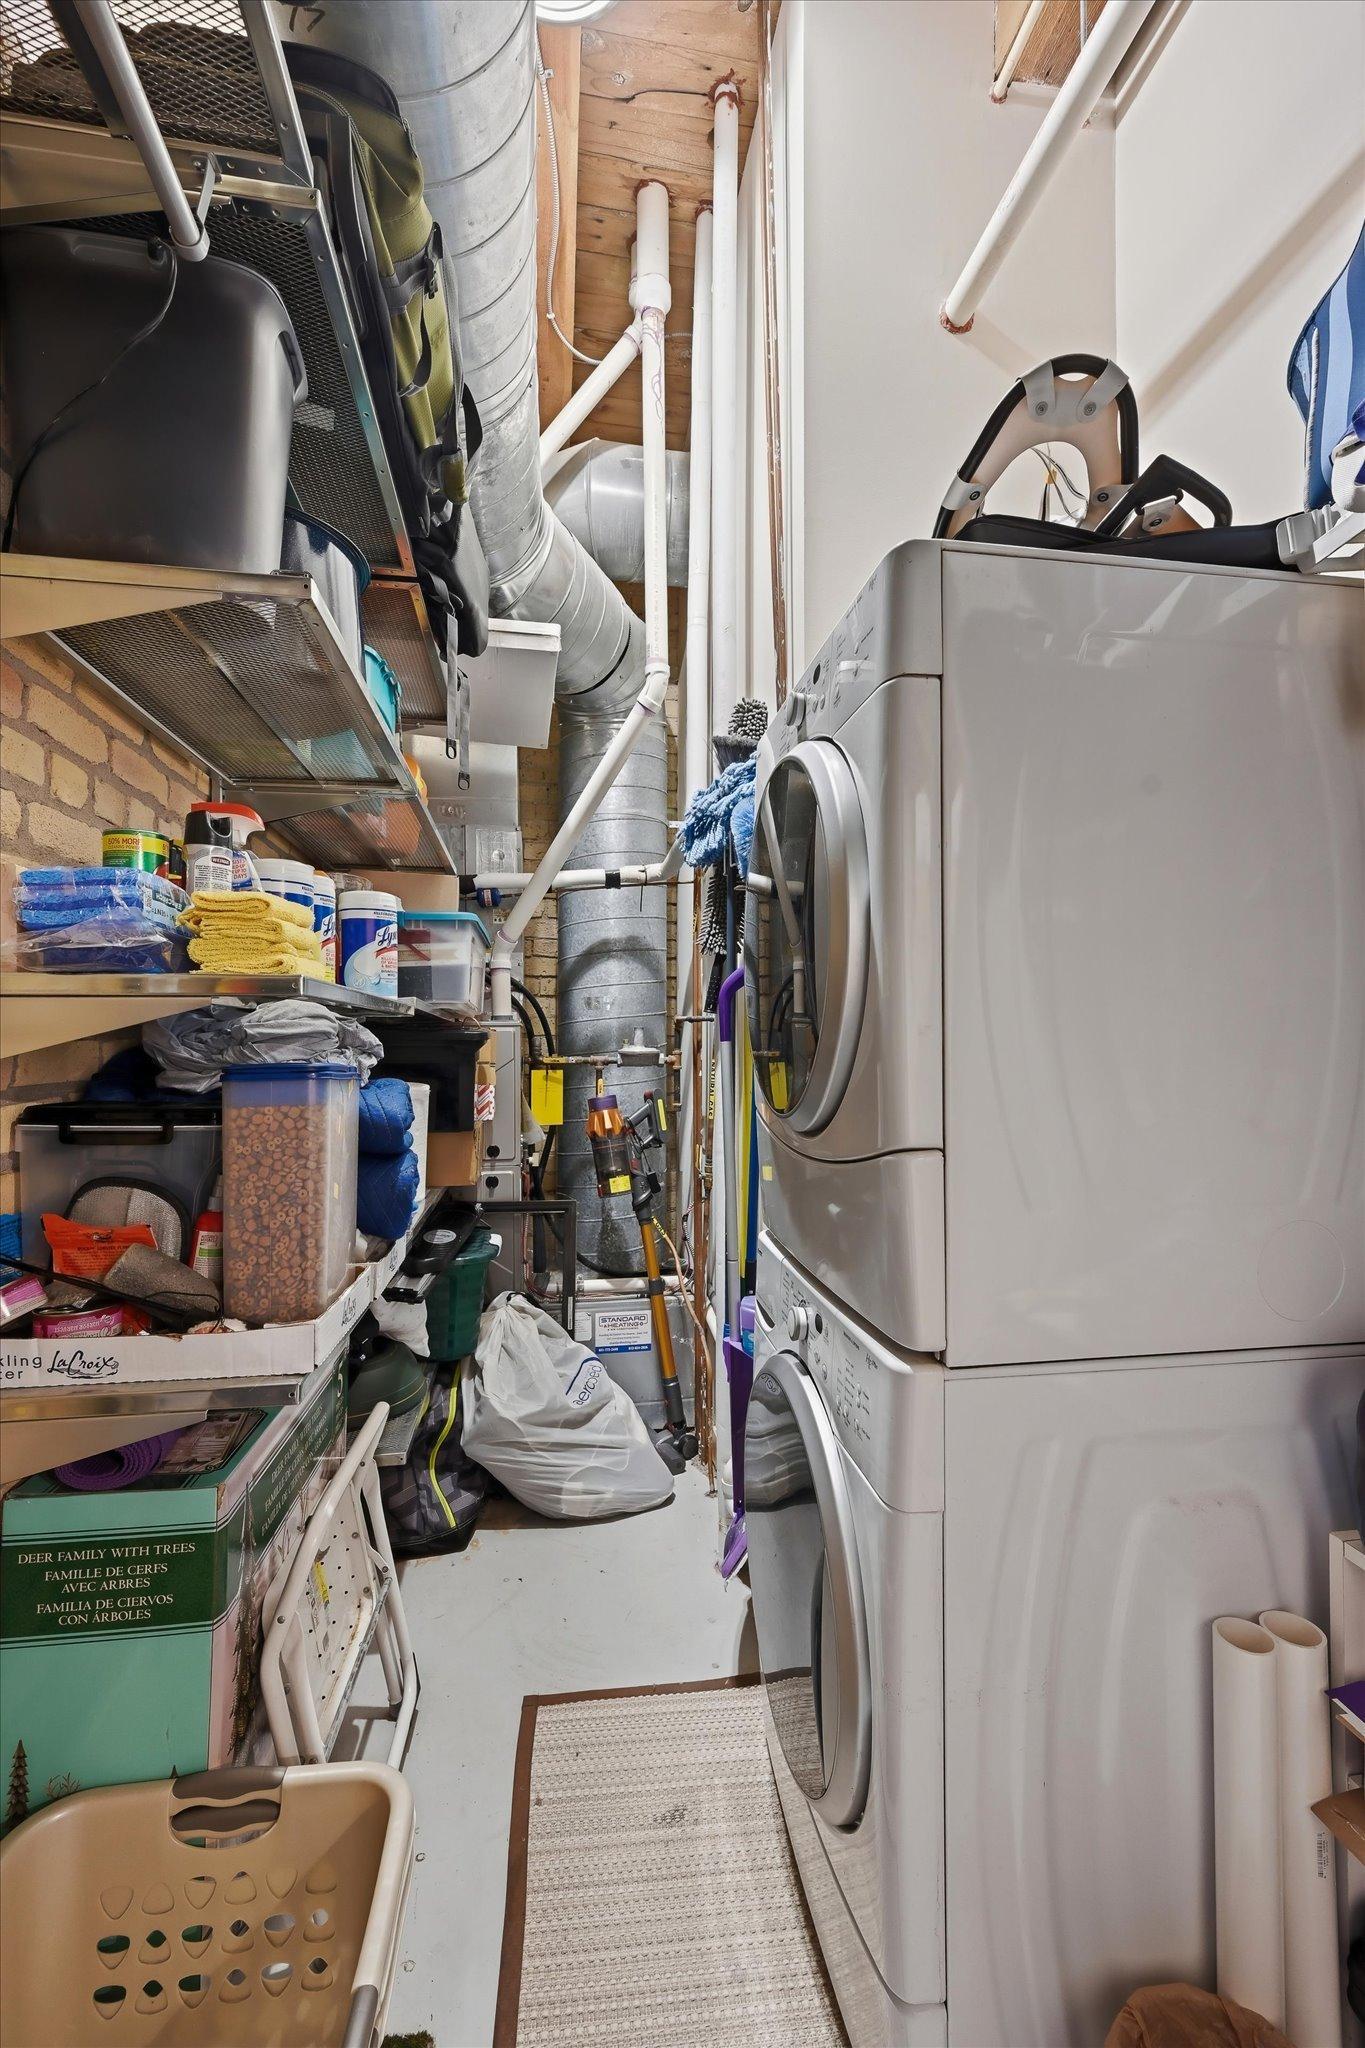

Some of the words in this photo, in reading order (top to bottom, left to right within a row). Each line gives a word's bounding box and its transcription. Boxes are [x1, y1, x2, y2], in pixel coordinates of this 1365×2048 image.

[601, 1315, 646, 1324] STANDARD
[47, 1350, 119, 1379] LaCroix
[18, 1552, 53, 1565] DEER
[57, 1549, 107, 1562] FAMILY
[111, 1545, 150, 1558] WITH
[153, 1542, 196, 1555] TREES
[45, 1567, 102, 1581] FAMILLE
[105, 1565, 124, 1577] DE
[127, 1563, 168, 1575] CERFS
[61, 1581, 97, 1594] AVEC
[99, 1577, 151, 1591] ARBRES
[36, 1600, 91, 1614] FAMILIA
[95, 1598, 114, 1610] DE
[117, 1593, 174, 1608] CIERVOS
[58, 1613, 88, 1626] CON
[92, 1609, 151, 1624] ÁRBOLES
